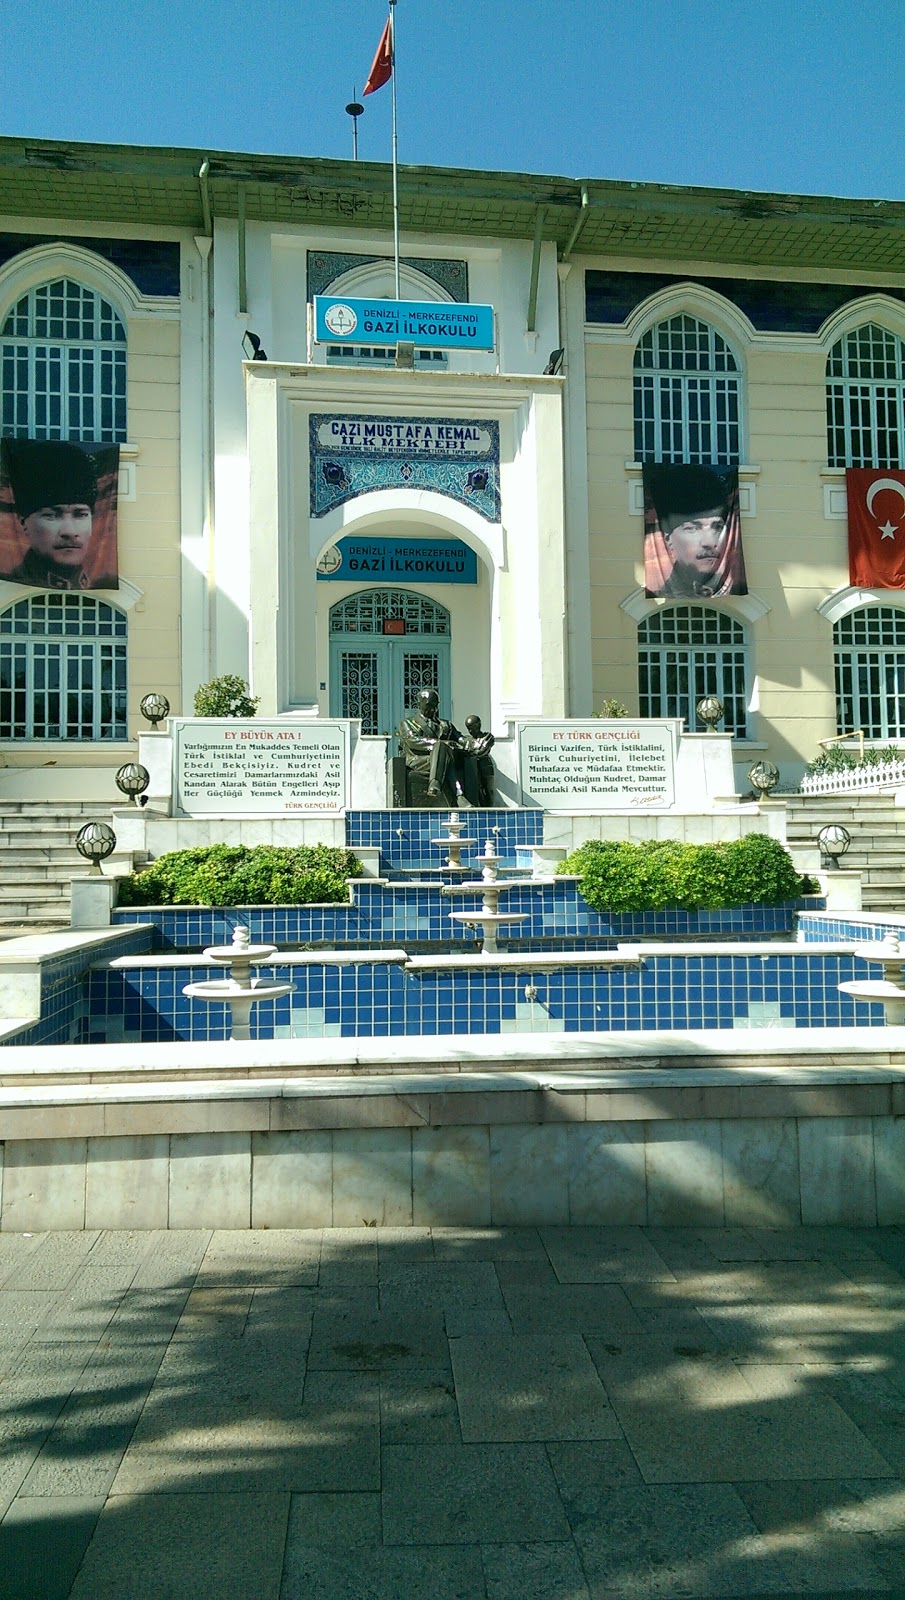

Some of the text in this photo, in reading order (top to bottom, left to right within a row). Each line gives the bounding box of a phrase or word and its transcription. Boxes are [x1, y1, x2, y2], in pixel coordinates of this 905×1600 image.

[364, 309, 400, 319] DENİZLİ
[409, 312, 479, 323] MERKEZEFENDİ
[364, 320, 399, 334] GAZİ
[404, 321, 477, 337] İLKOKULU
[332, 422, 480, 441] GAZİ MUSTAFA KEMAL
[342, 435, 375, 446] İLK
[382, 437, 466, 450] MEKTEBİ
[349, 546, 386, 555] DENİZLİ
[395, 549, 467, 558] MERKEZEFENDİ
[349, 557, 385, 571] GAZİ
[391, 558, 465, 572] İLKOKULU
[225, 730, 301, 740] EY BÜYÜK ATA !
[567, 731, 592, 740] TÜRK
[595, 730, 640, 741] GENÇLİĞİ
[622, 744, 665, 752] İstiklalini,
[213, 751, 246, 760] İstiklal
[272, 753, 340, 761] Cumhuriyetinin
[559, 755, 621, 763] Cuhuriyetini,
[629, 754, 665, 762] İlelebet
[223, 763, 279, 771] Bekçisiyiz.
[282, 781, 318, 789] Engelleri
[323, 781, 340, 789] Aşıp
[529, 776, 561, 784] Muhtaç
[564, 776, 601, 784] Olduğun
[207, 790, 243, 798] Güçlüğü
[290, 790, 340, 798] Azmindeyiz.
[304, 801, 337, 809] GENÇLİĞİ
